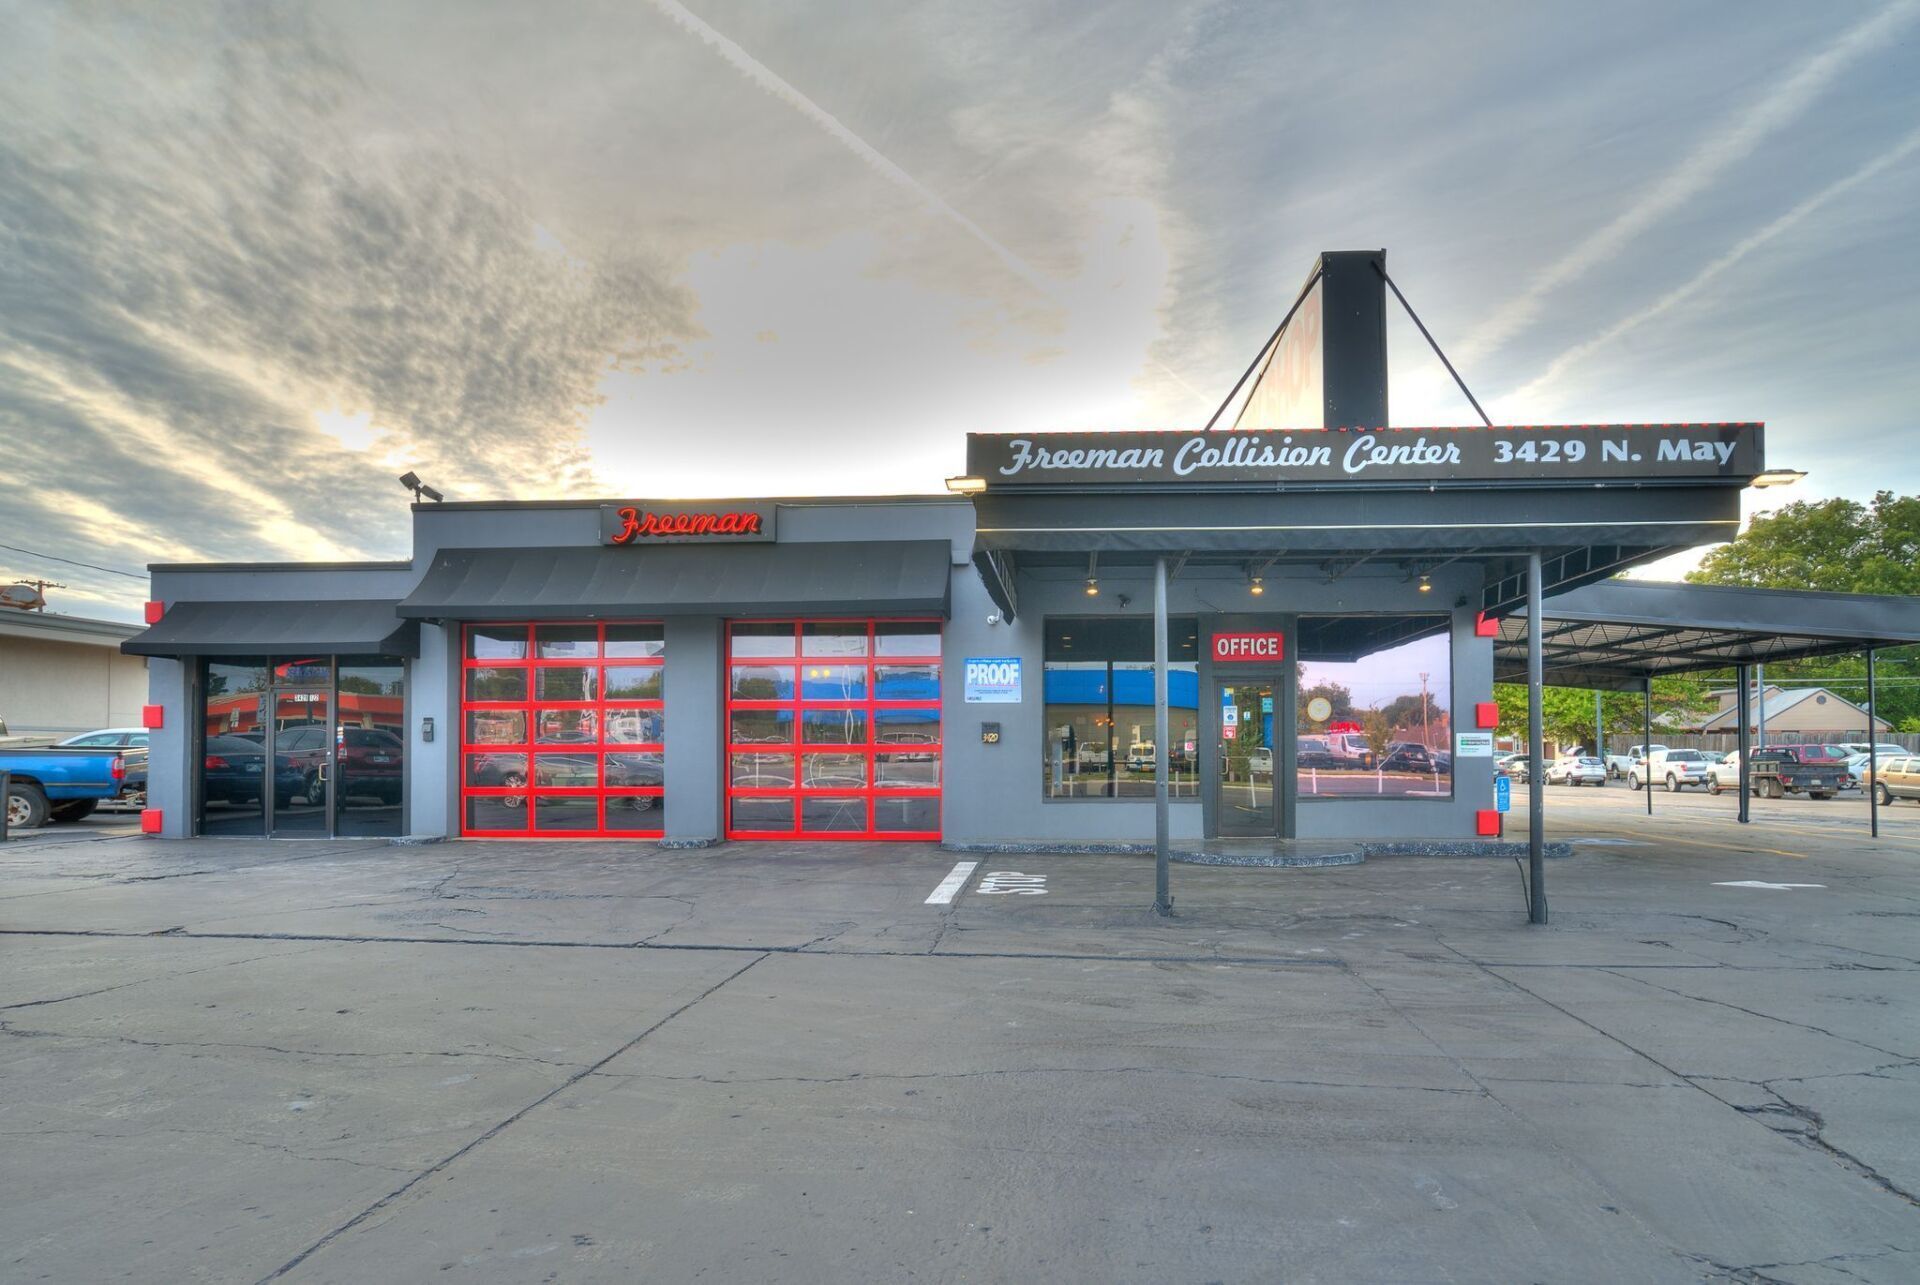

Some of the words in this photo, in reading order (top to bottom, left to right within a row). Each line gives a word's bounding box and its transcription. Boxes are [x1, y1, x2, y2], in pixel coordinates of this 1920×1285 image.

[1000, 439, 1163, 475] Freeman
[1173, 437, 1330, 475] Collision
[1342, 434, 1461, 473] Center
[1494, 440, 1586, 463] 3429
[1602, 440, 1641, 462] N.
[1657, 439, 1737, 465] May
[611, 507, 760, 544] Freeman
[1217, 638, 1278, 656] OFFICE
[967, 663, 1019, 685] PROOF
[976, 871, 1049, 895] STOP
